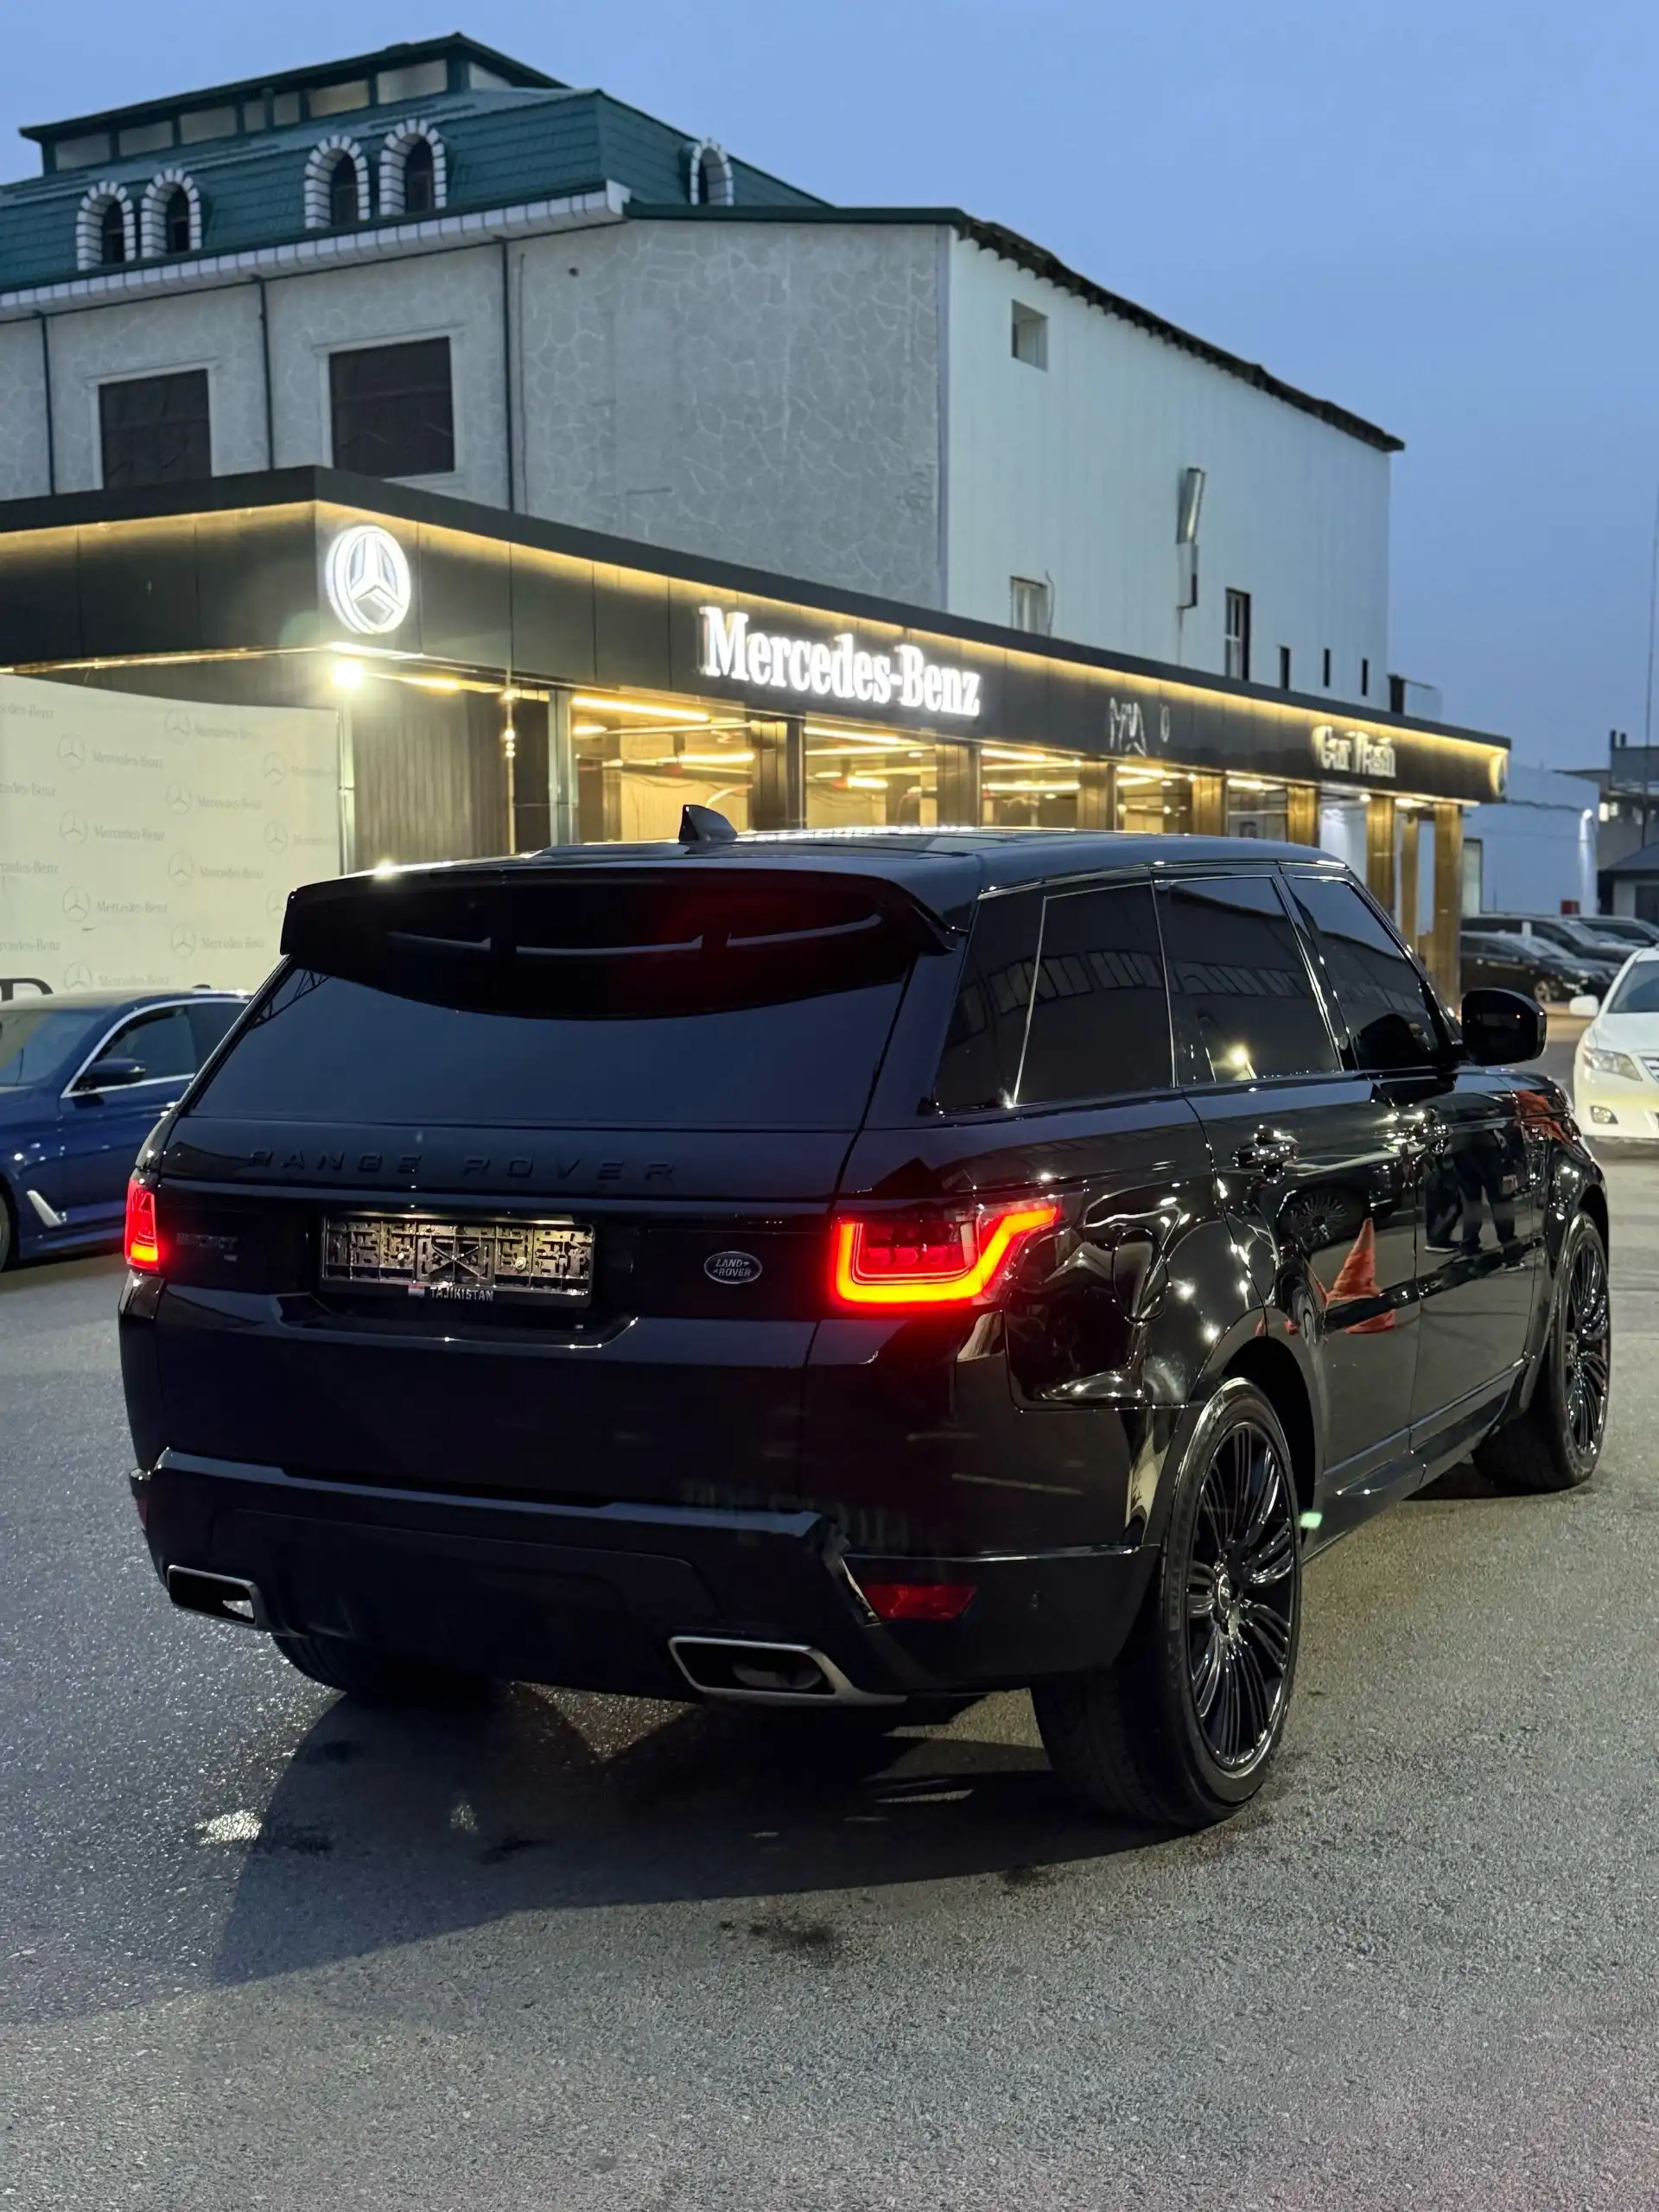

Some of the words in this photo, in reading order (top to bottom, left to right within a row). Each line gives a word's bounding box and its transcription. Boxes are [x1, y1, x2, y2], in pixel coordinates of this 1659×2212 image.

[698, 606, 982, 717] Mercedes-Benz
[248, 1149, 422, 1174] RANGE
[463, 1155, 676, 1182] ROVER
[716, 1268, 752, 1277] ROVER
[430, 1286, 494, 1302] TAJIKISTAN
